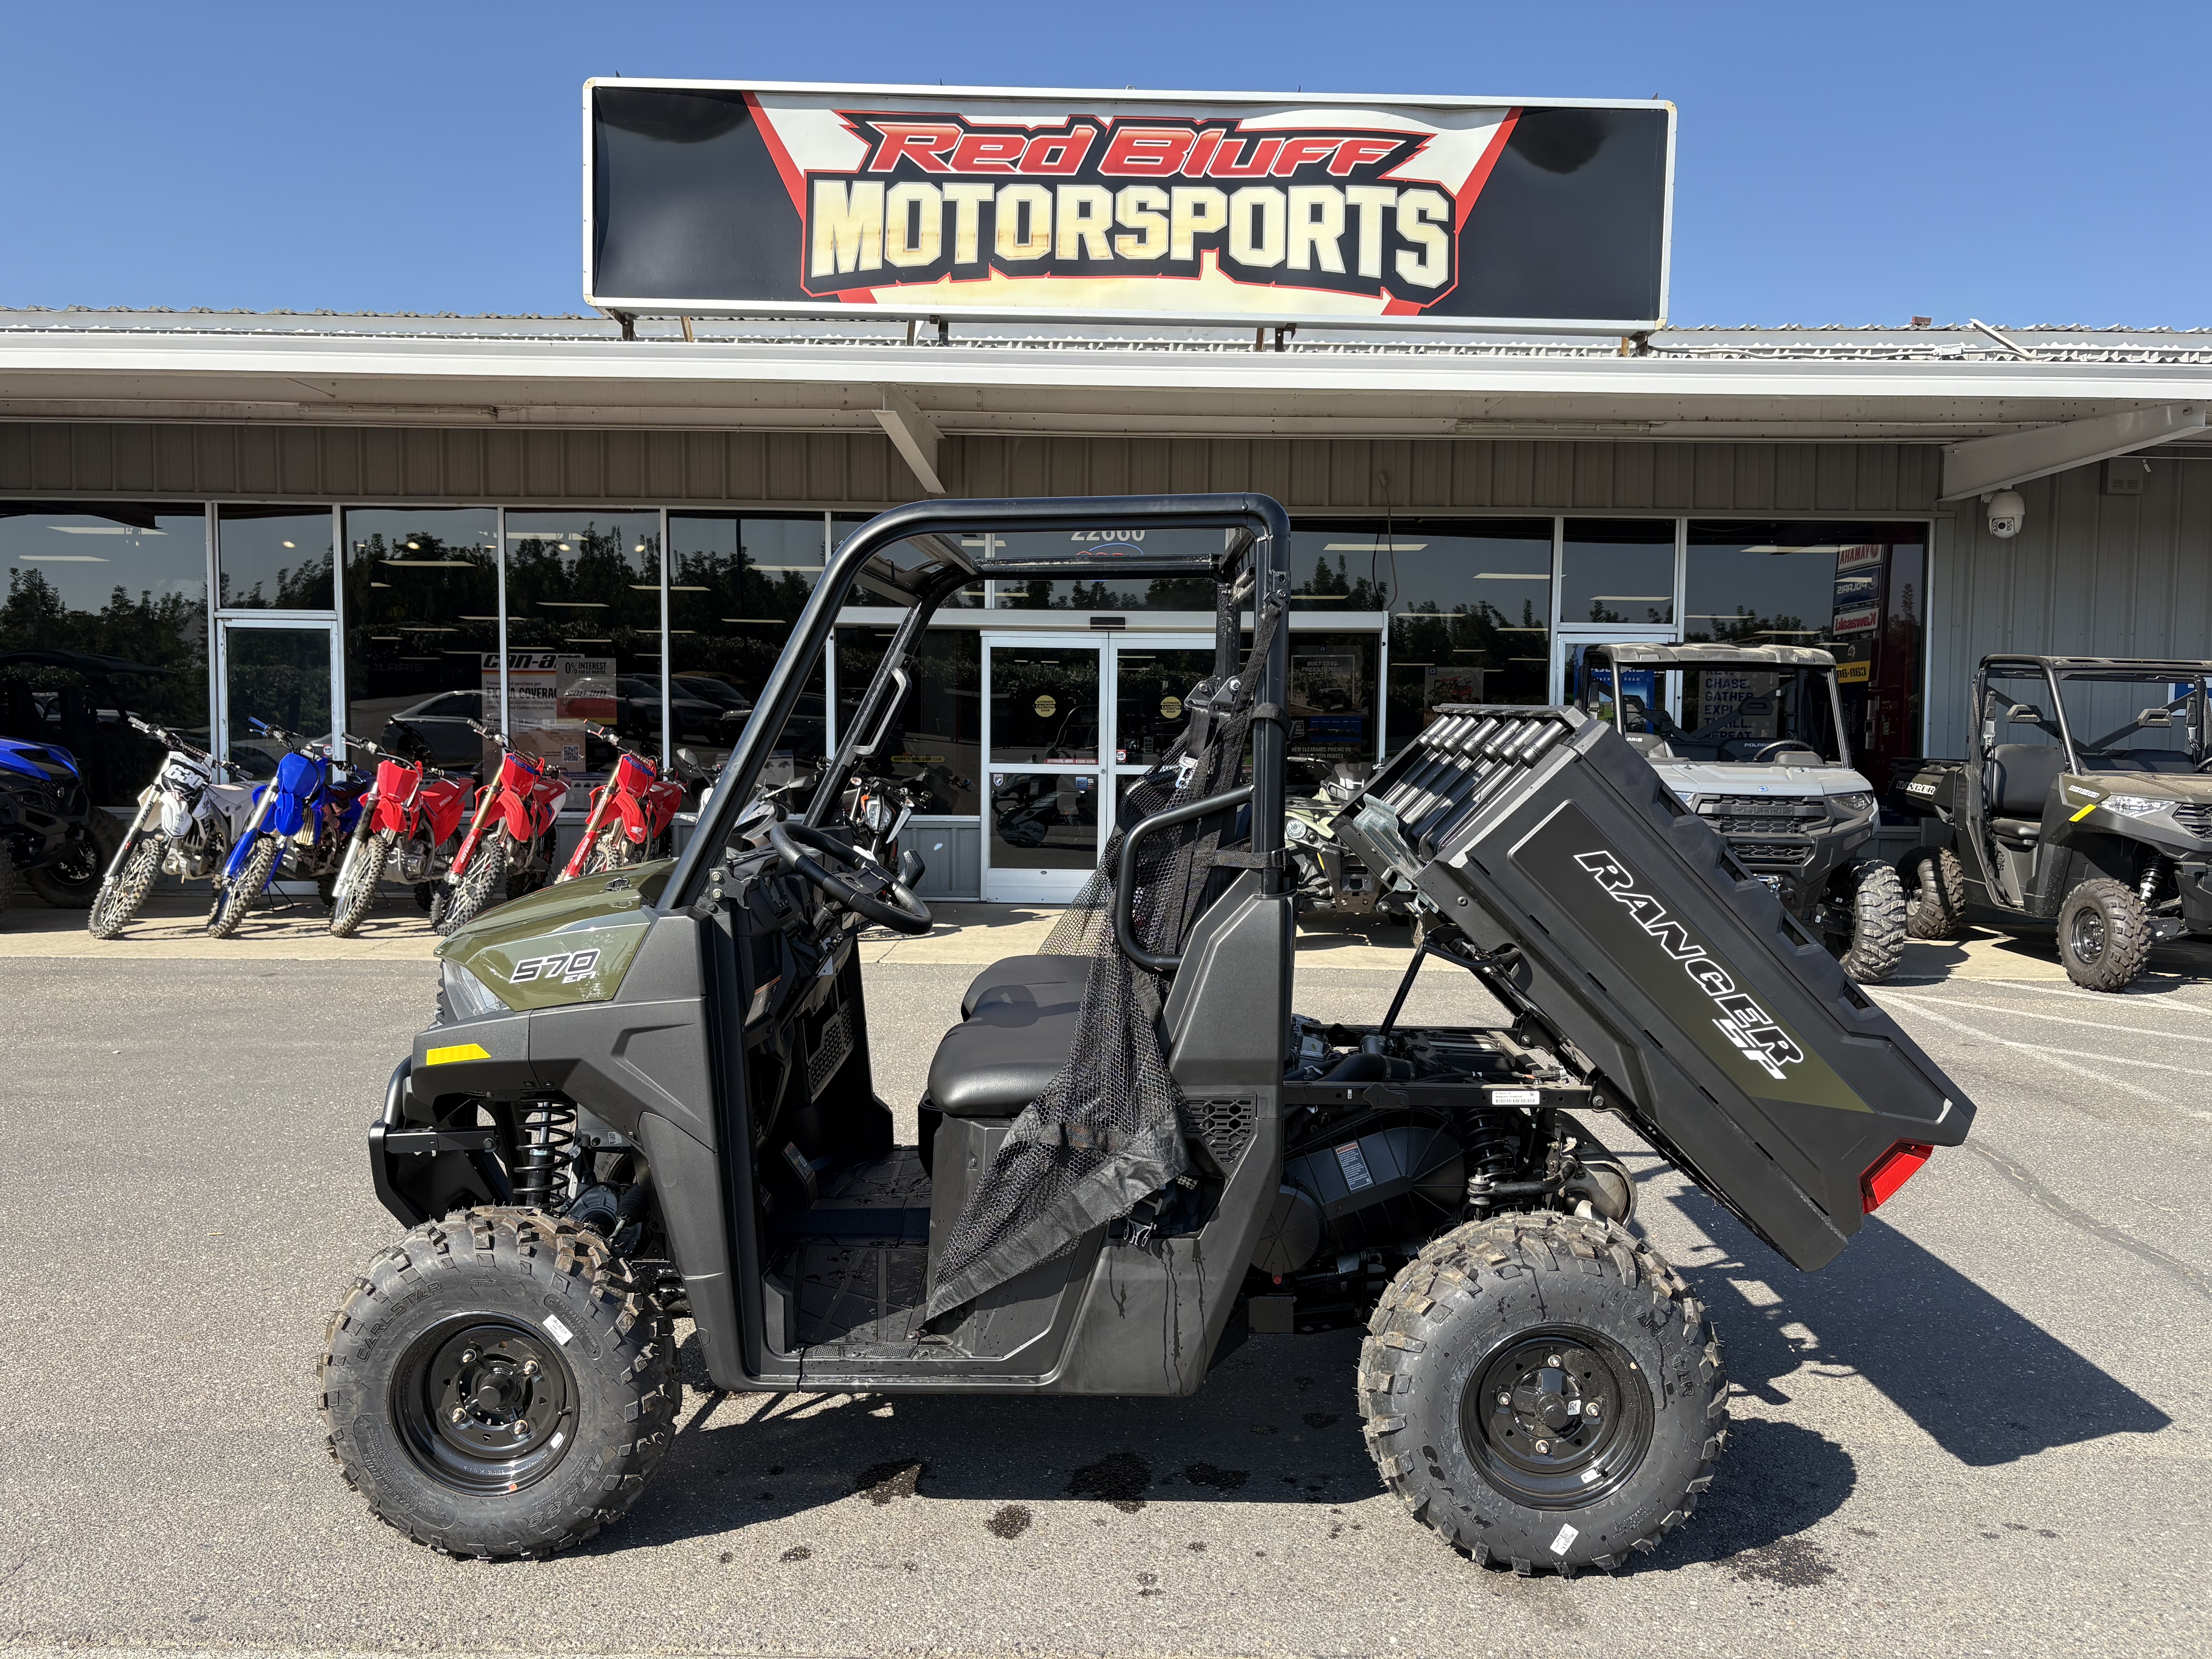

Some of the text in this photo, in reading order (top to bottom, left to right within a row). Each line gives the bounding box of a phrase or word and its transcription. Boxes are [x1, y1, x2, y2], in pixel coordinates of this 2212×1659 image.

[865, 121, 1406, 179] Red Bluff
[811, 179, 1449, 289] MOTORSPORTS
[565, 662, 577, 674] 0%
[1705, 678, 1750, 689] CHASE.
[165, 764, 204, 790] 630
[1896, 780, 1936, 796] RANGER
[2068, 784, 2100, 799] 1000
[1734, 806, 1793, 815] POLARIS
[460, 835, 476, 864] DUNLOP
[575, 837, 590, 866] DUNLOP
[508, 948, 601, 984] 570
[1574, 850, 1804, 1067] RANGER
[562, 970, 597, 984] EFI
[1712, 1019, 1786, 1080] SP
[355, 1280, 444, 1362] CARLSTAR
[523, 1450, 615, 1529] AT489
